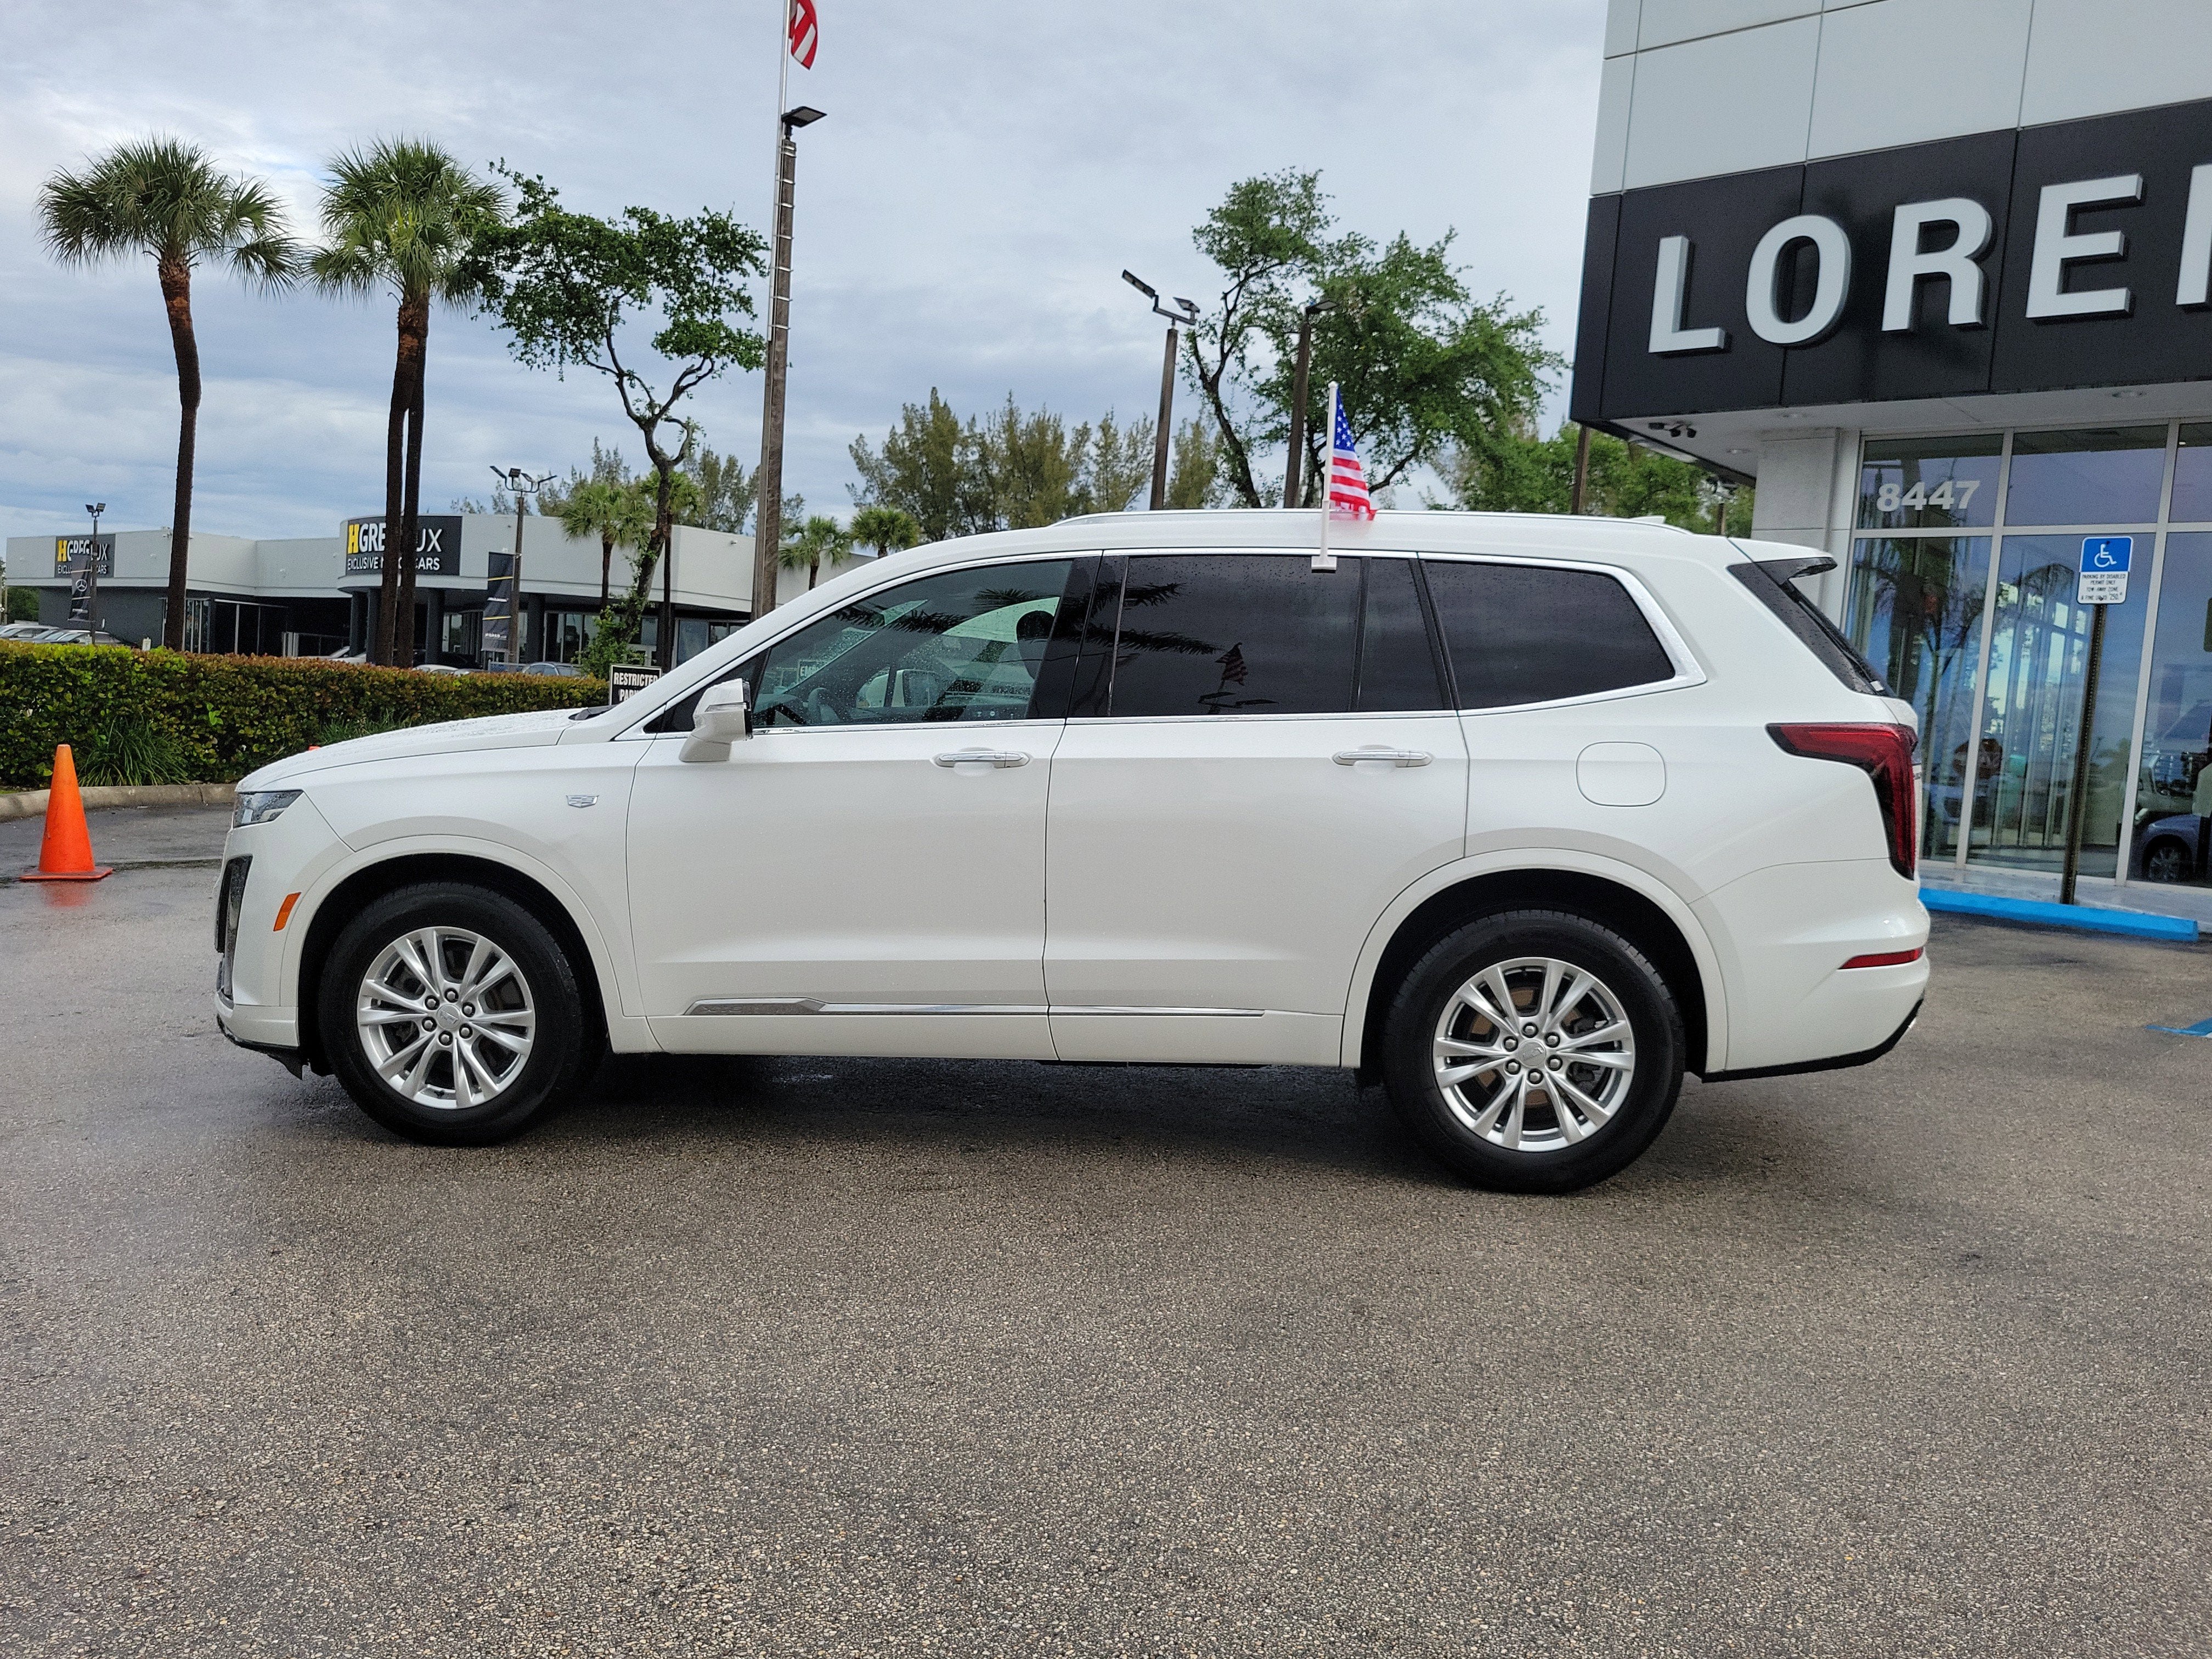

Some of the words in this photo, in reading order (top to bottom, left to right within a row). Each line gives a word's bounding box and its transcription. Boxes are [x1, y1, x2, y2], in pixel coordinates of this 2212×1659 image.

[1877, 481, 1980, 512] 8447
[347, 556, 379, 570] EXCLUSIVE
[613, 672, 658, 686] RESTRICTED
